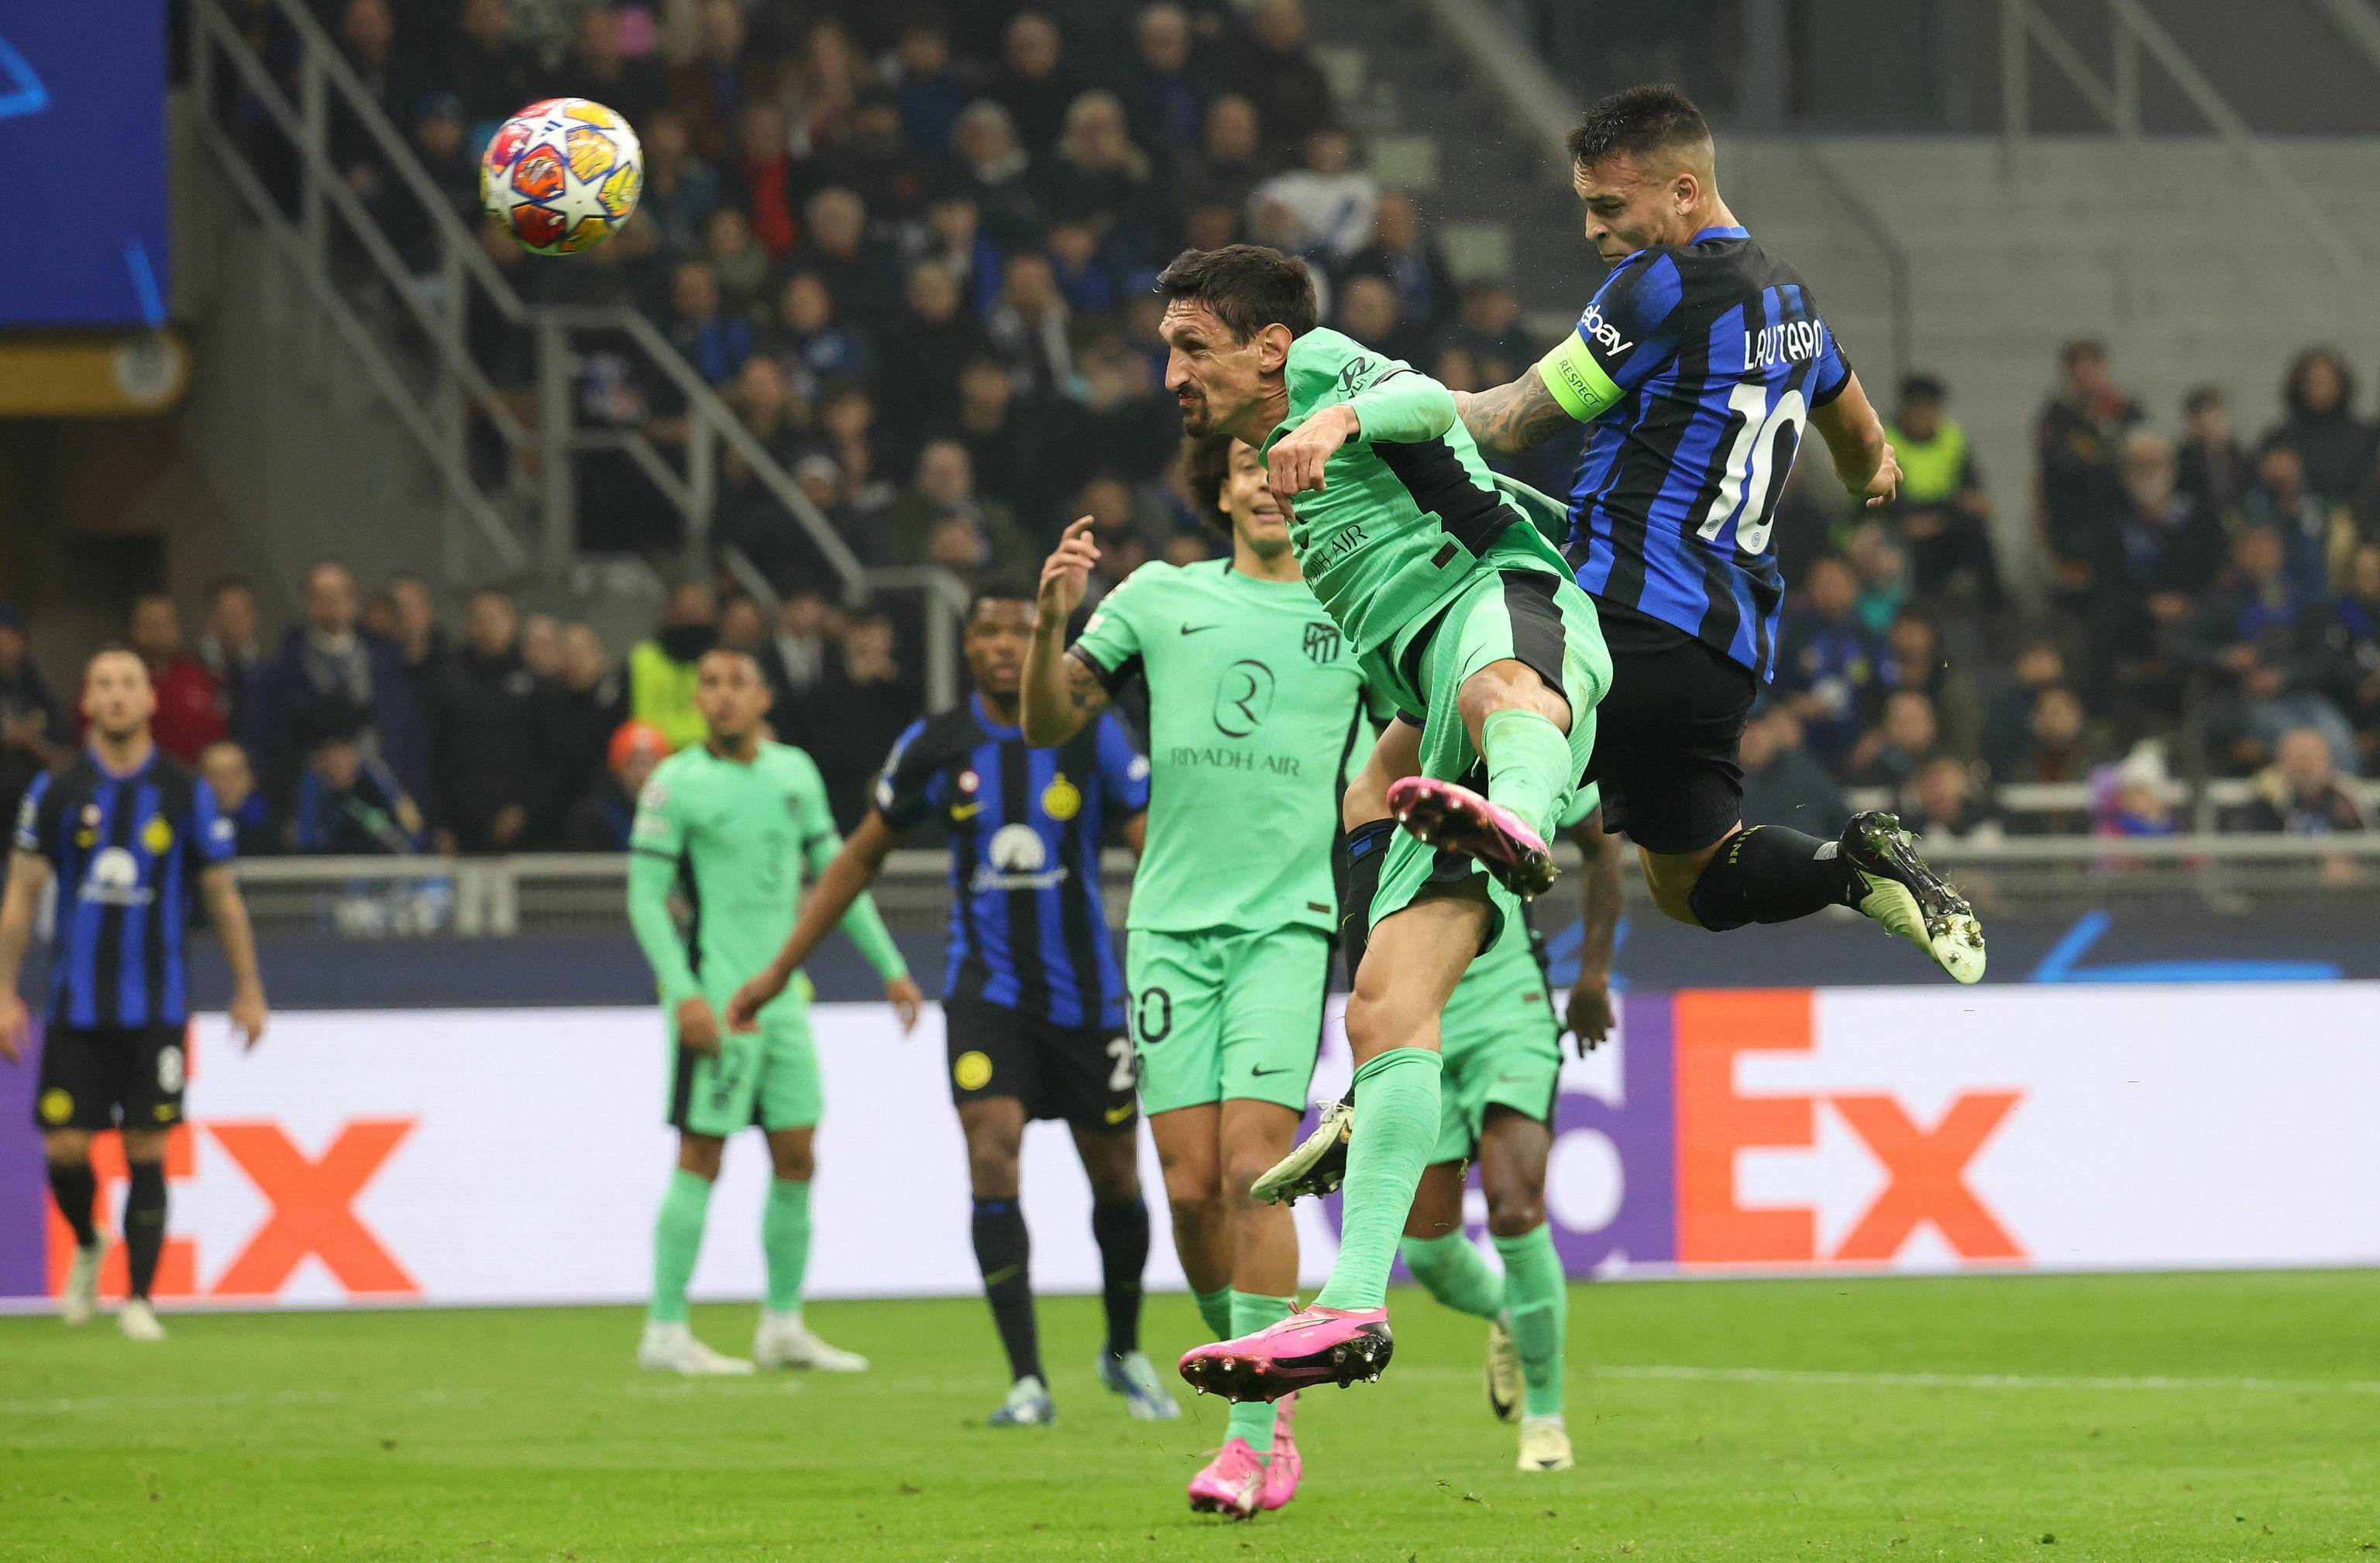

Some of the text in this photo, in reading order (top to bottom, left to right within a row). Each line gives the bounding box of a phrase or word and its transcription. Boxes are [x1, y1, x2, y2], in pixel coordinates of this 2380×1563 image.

[1580, 304, 1633, 357] ebay
[1559, 359, 1600, 407] RESPECT
[1696, 383, 1807, 555] 10
[1332, 524, 1369, 562] AIR
[1171, 747, 1300, 777] RIYADH AIR
